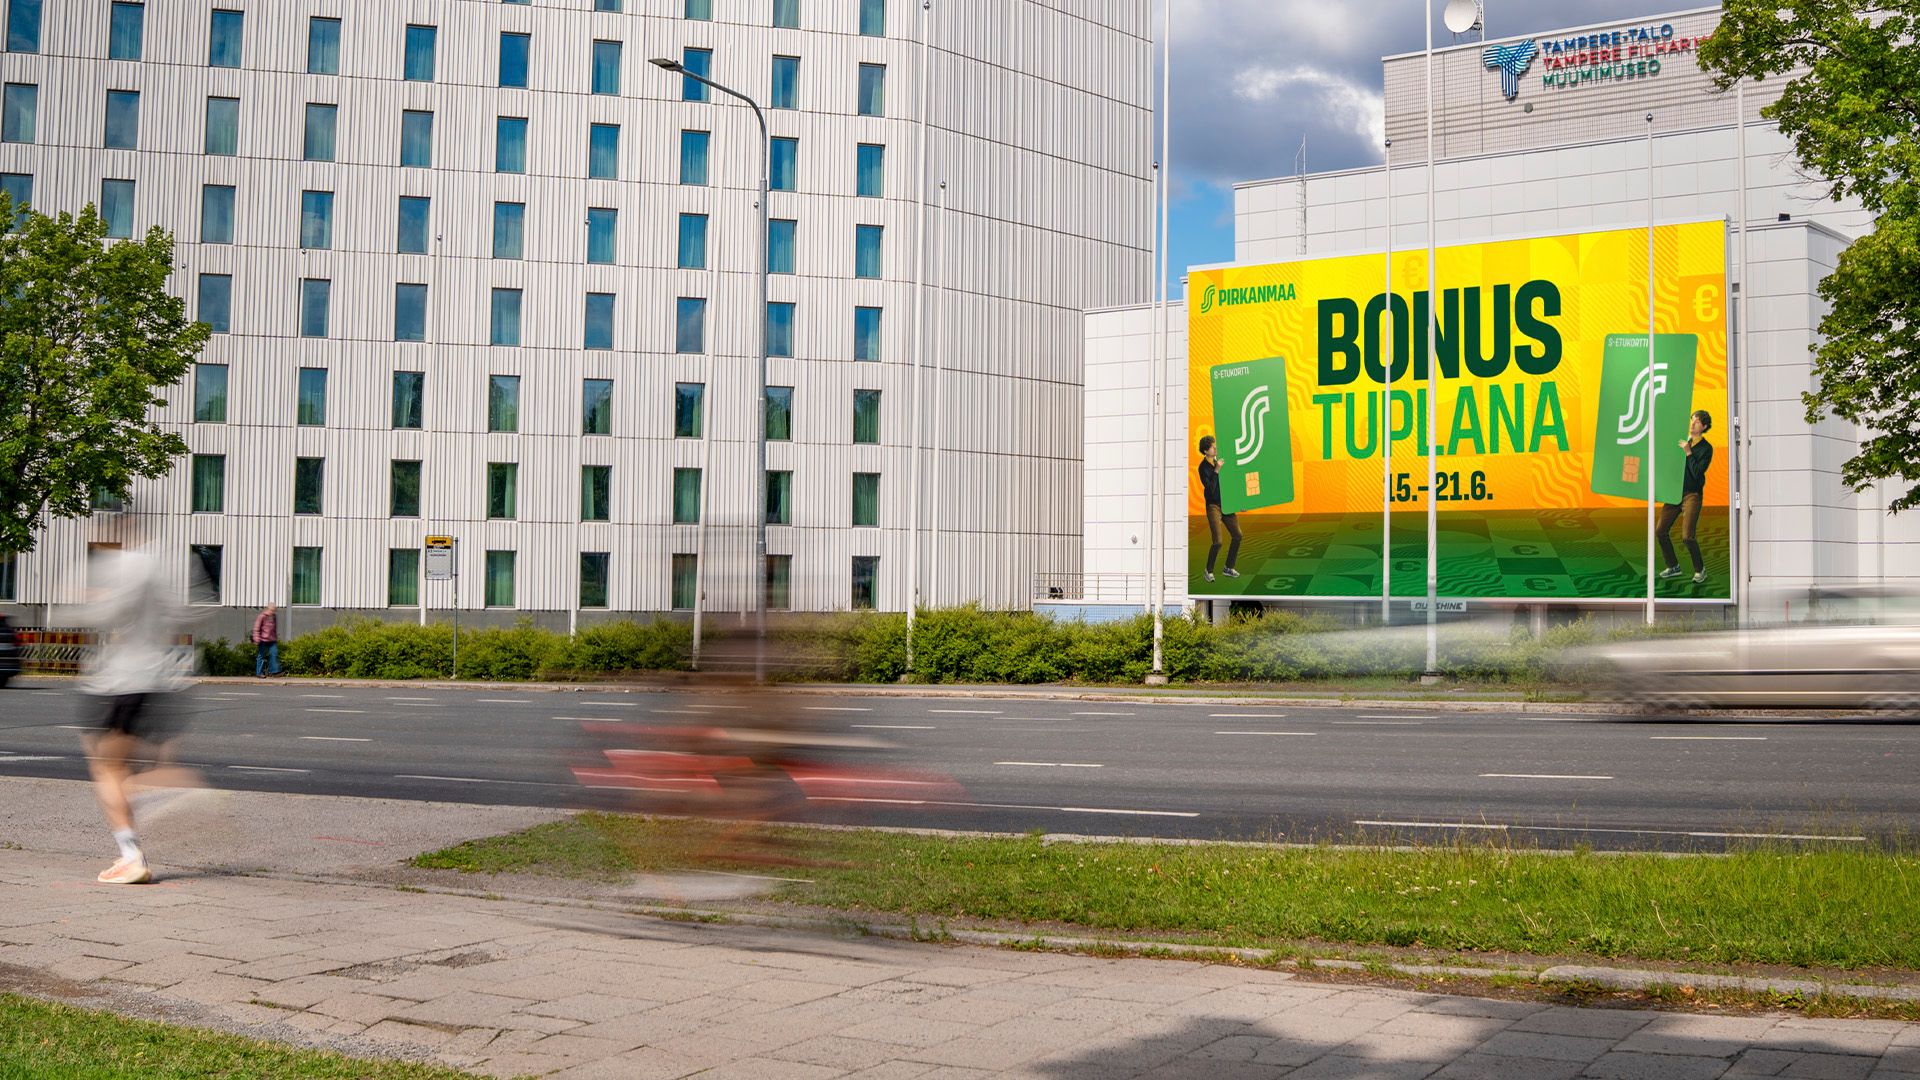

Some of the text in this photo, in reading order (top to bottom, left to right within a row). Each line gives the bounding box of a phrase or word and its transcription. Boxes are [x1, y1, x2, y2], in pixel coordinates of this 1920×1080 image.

[1542, 23, 1673, 55] TAMPERE-TALO
[1542, 48, 1622, 71] TAMPERE
[1542, 59, 1662, 88] MUUMIMUSEO
[1218, 283, 1296, 307] PIRKANMAA
[1317, 279, 1563, 387] BONUS
[1213, 366, 1250, 380] S-ETUKORTTI
[1312, 381, 1570, 460] TUPLANA
[1414, 601, 1463, 610] OUSHINE
